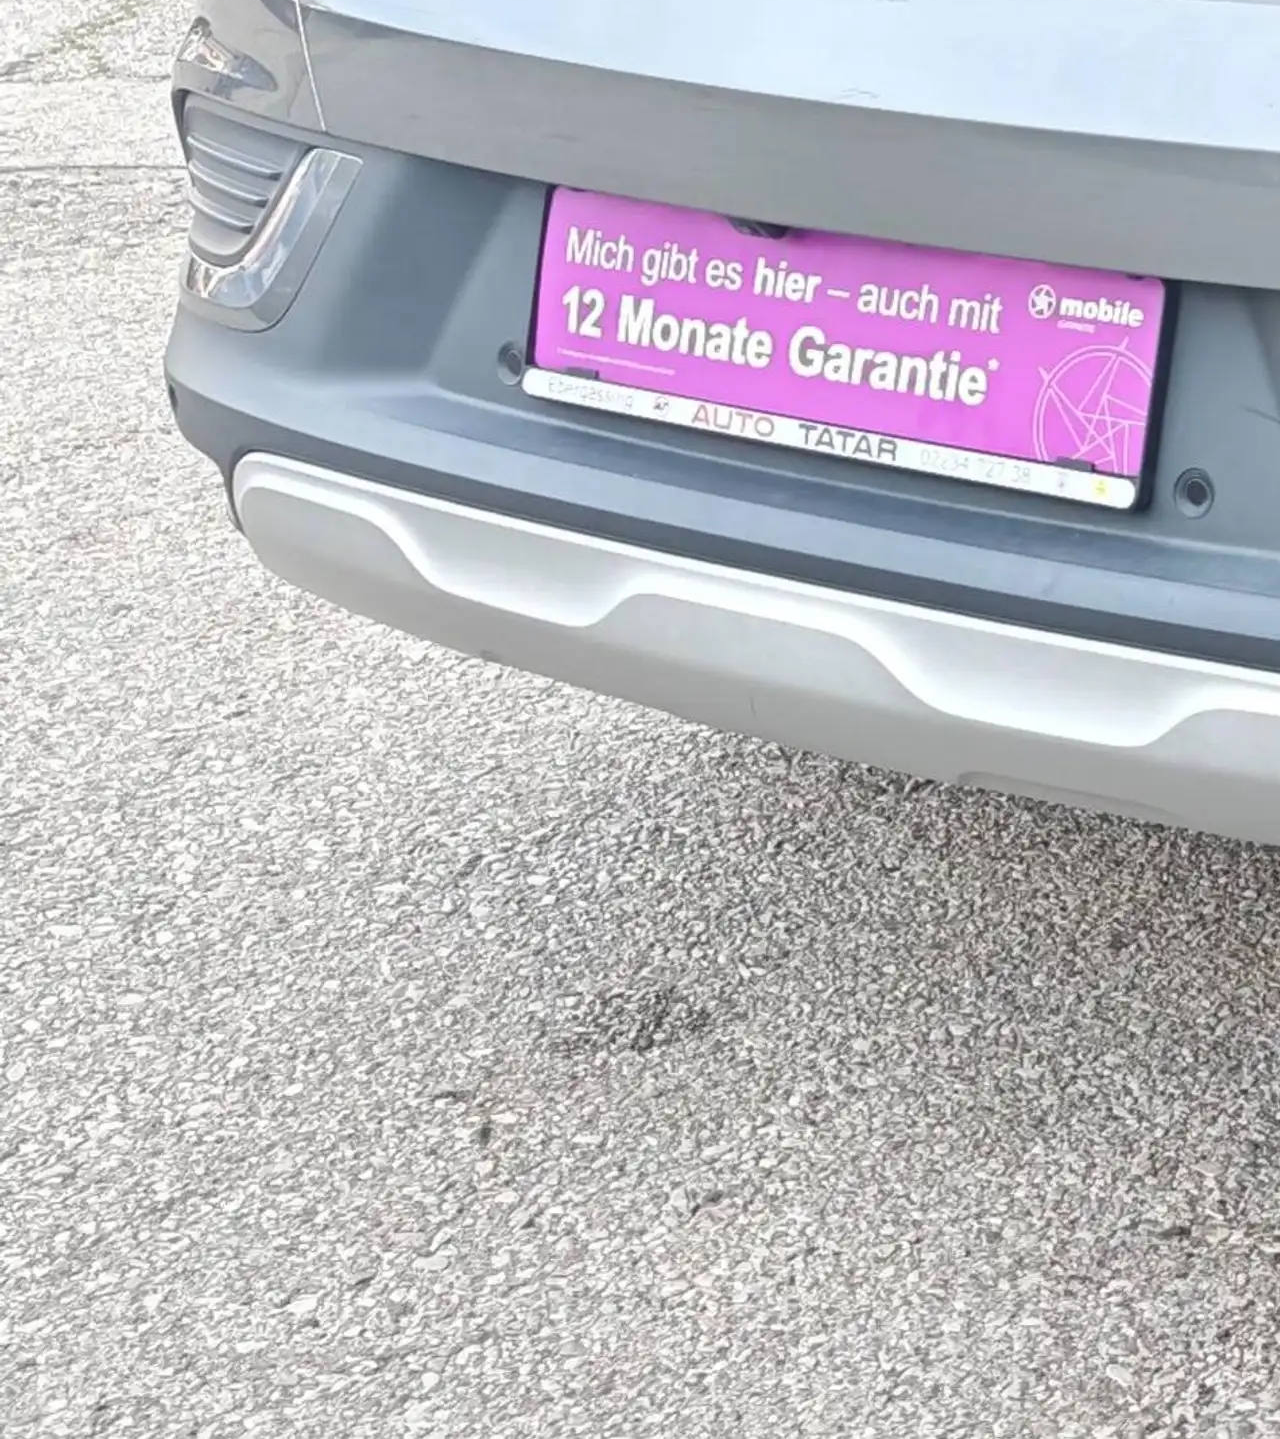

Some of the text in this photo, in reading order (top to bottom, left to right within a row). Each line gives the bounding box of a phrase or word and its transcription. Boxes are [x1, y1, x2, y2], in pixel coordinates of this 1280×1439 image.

[564, 225, 635, 274] Mich
[641, 242, 699, 287] gibt
[705, 257, 743, 291] es
[753, 257, 822, 304] hier
[856, 282, 939, 323] auch
[948, 296, 1003, 335] mit
[1060, 296, 1145, 328] mobile
[560, 285, 605, 339] 12
[616, 293, 774, 369] Monate
[691, 403, 775, 438] AUTO
[798, 422, 898, 462] TATAR
